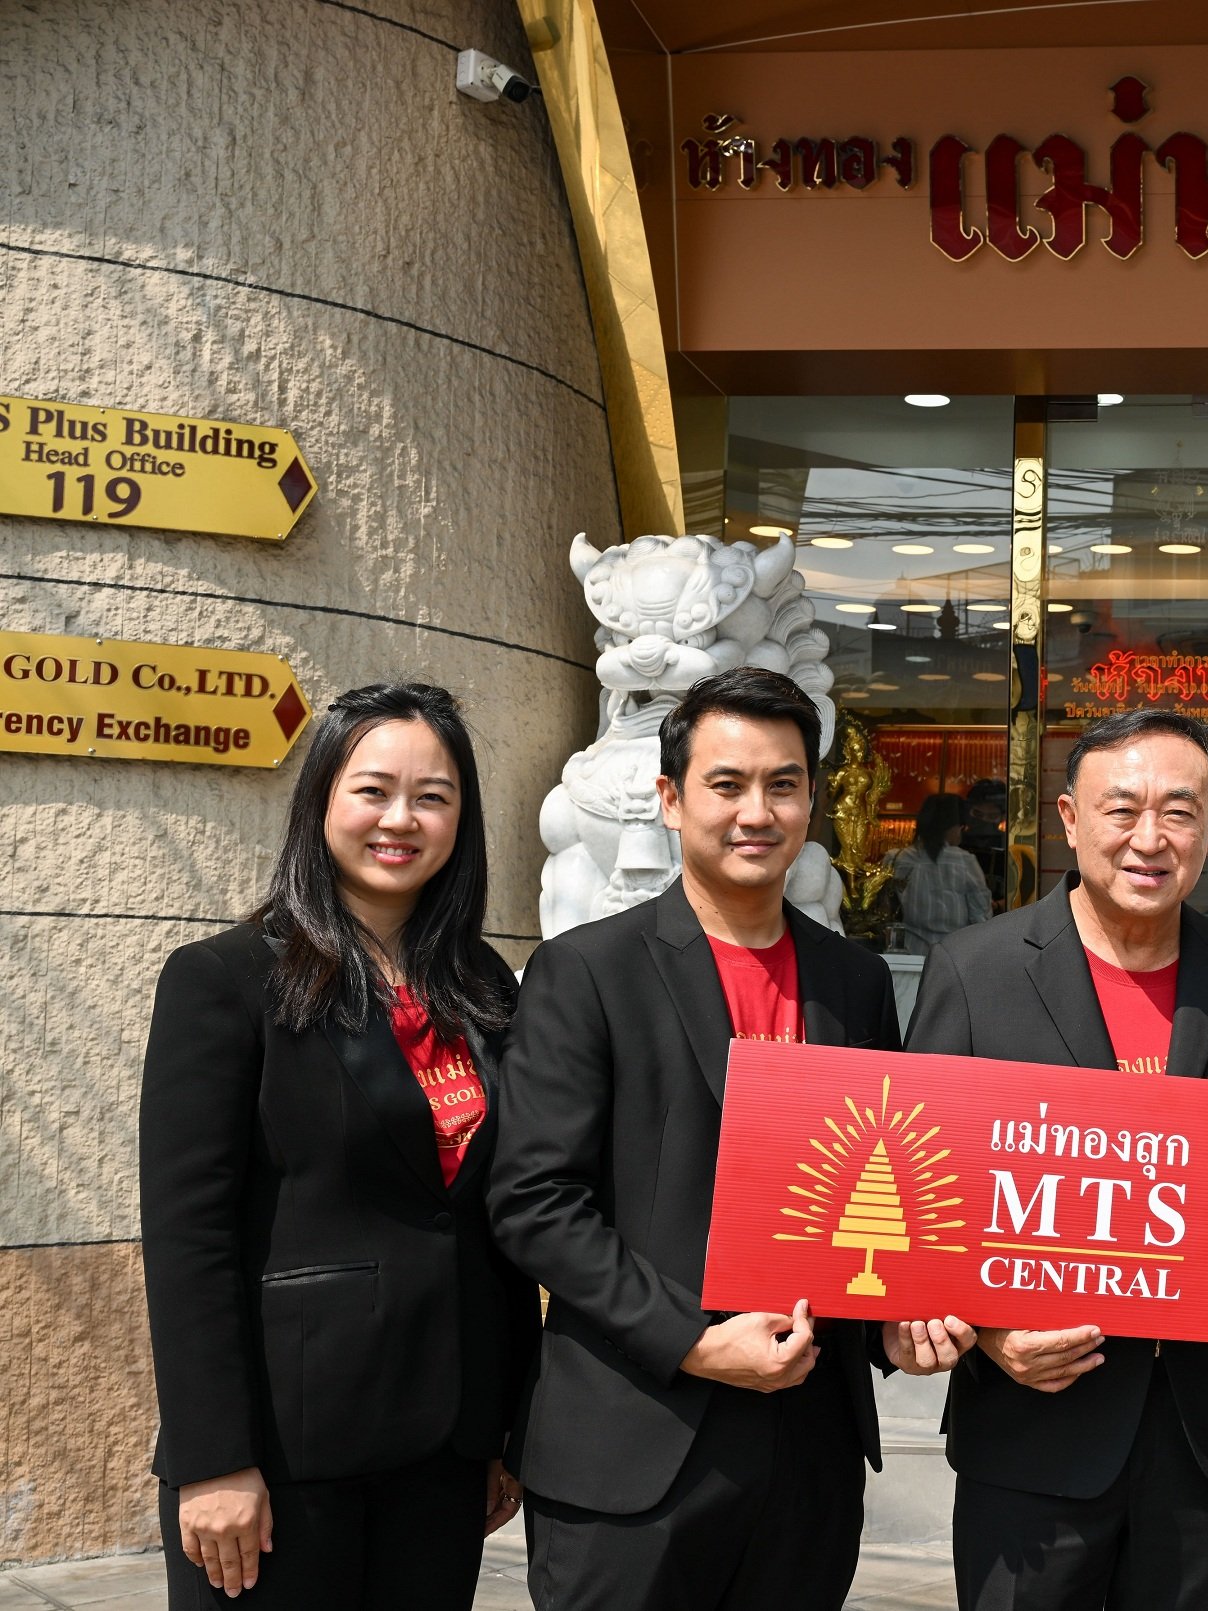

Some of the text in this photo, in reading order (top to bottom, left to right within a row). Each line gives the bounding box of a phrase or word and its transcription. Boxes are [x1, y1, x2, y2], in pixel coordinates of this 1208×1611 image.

[680, 112, 917, 192] ห้างทอง
[22, 440, 186, 478] Head Office
[26, 406, 108, 443] Plus
[121, 416, 279, 469] Building
[46, 470, 142, 519] 119
[4, 654, 277, 700] GOLD Co.,LTD.
[96, 712, 250, 754] Exchange
[428, 1096, 441, 1111] S
[990, 1102, 1190, 1179] แม่ทองสุก
[984, 1169, 1187, 1247] MTS
[979, 1256, 1181, 1301] CENTRAL
